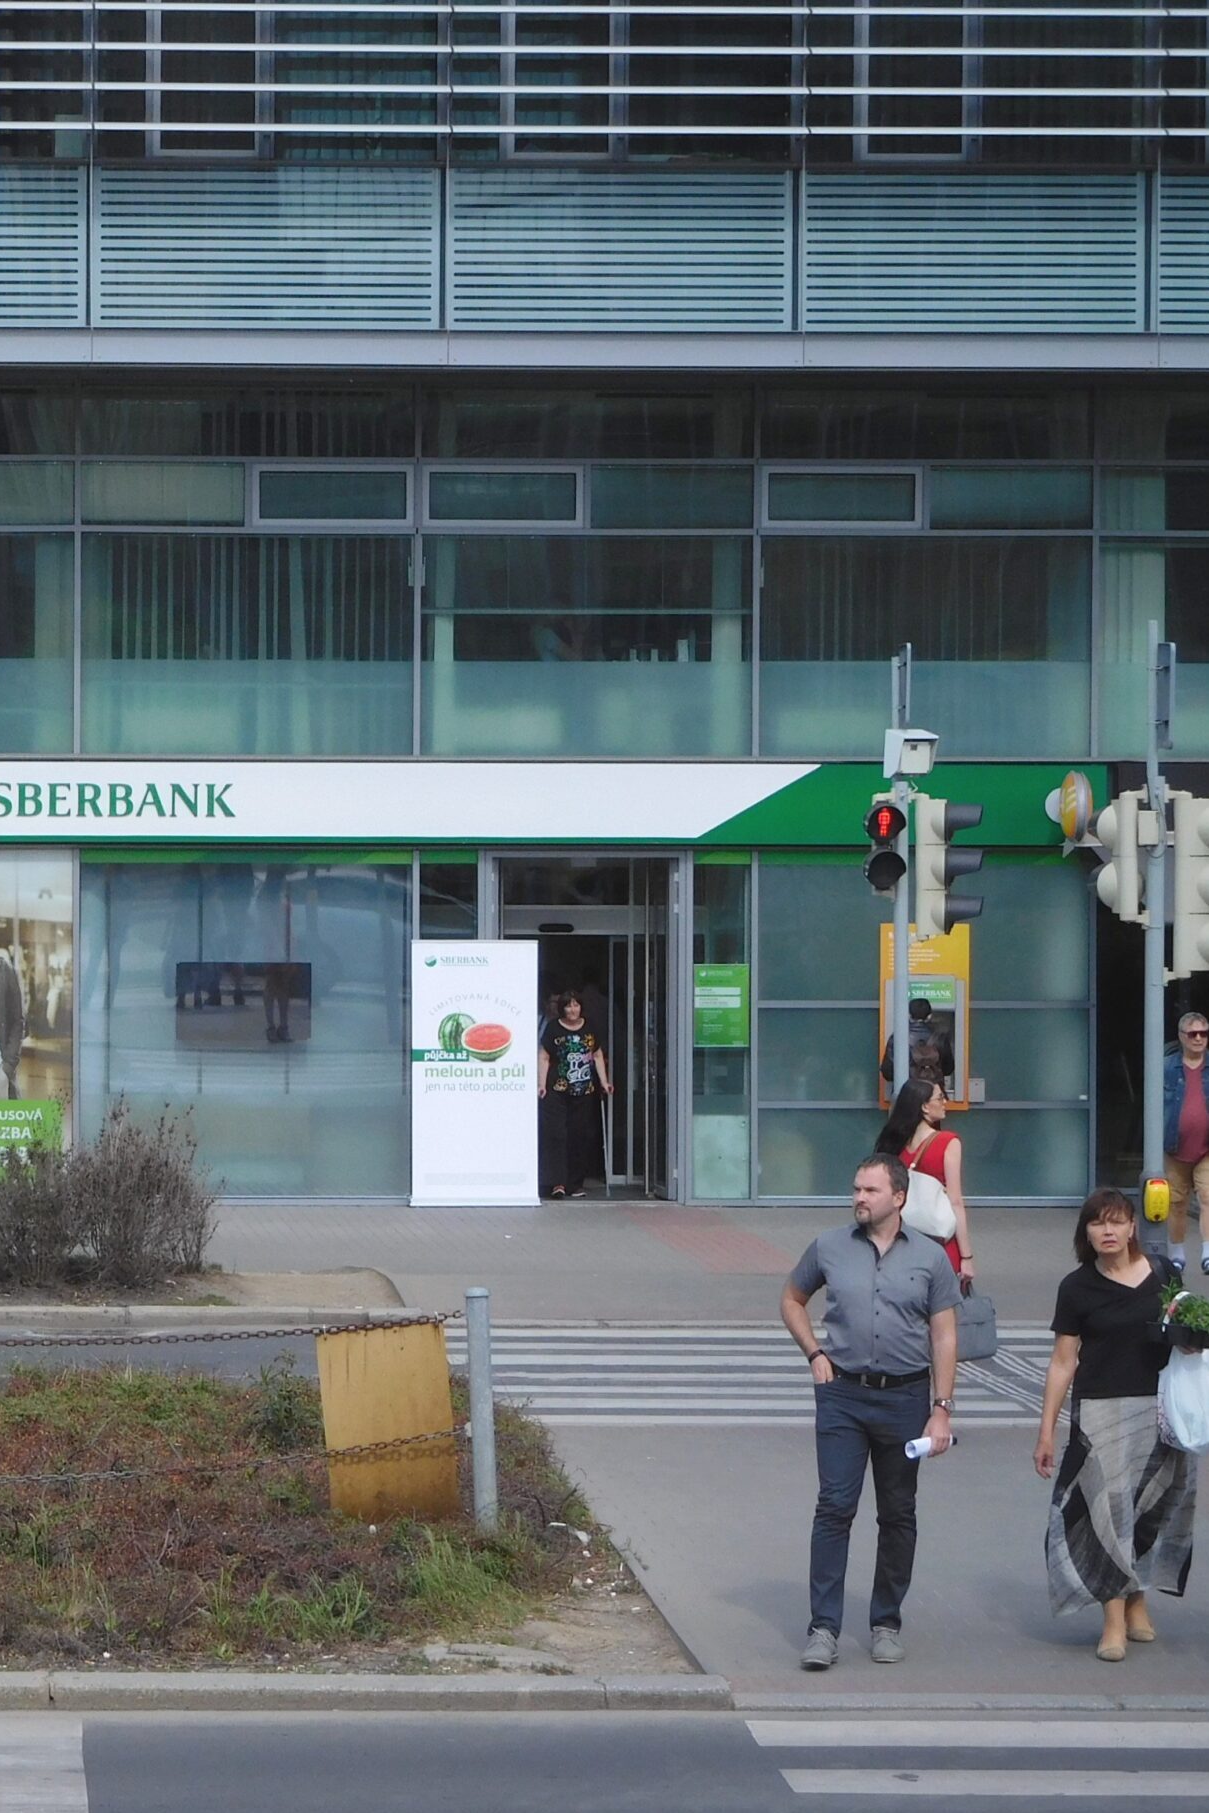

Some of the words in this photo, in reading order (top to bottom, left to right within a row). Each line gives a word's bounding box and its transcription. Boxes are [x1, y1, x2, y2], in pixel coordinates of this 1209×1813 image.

[424, 1050, 455, 1061] půjčka
[456, 1050, 467, 1060] až
[424, 1064, 483, 1078] meloun
[488, 1067, 497, 1078] a
[501, 1063, 525, 1081] půl
[425, 1082, 441, 1093] jen
[444, 1084, 456, 1092] na
[459, 1081, 480, 1092] této
[483, 1081, 526, 1093] pobočce
